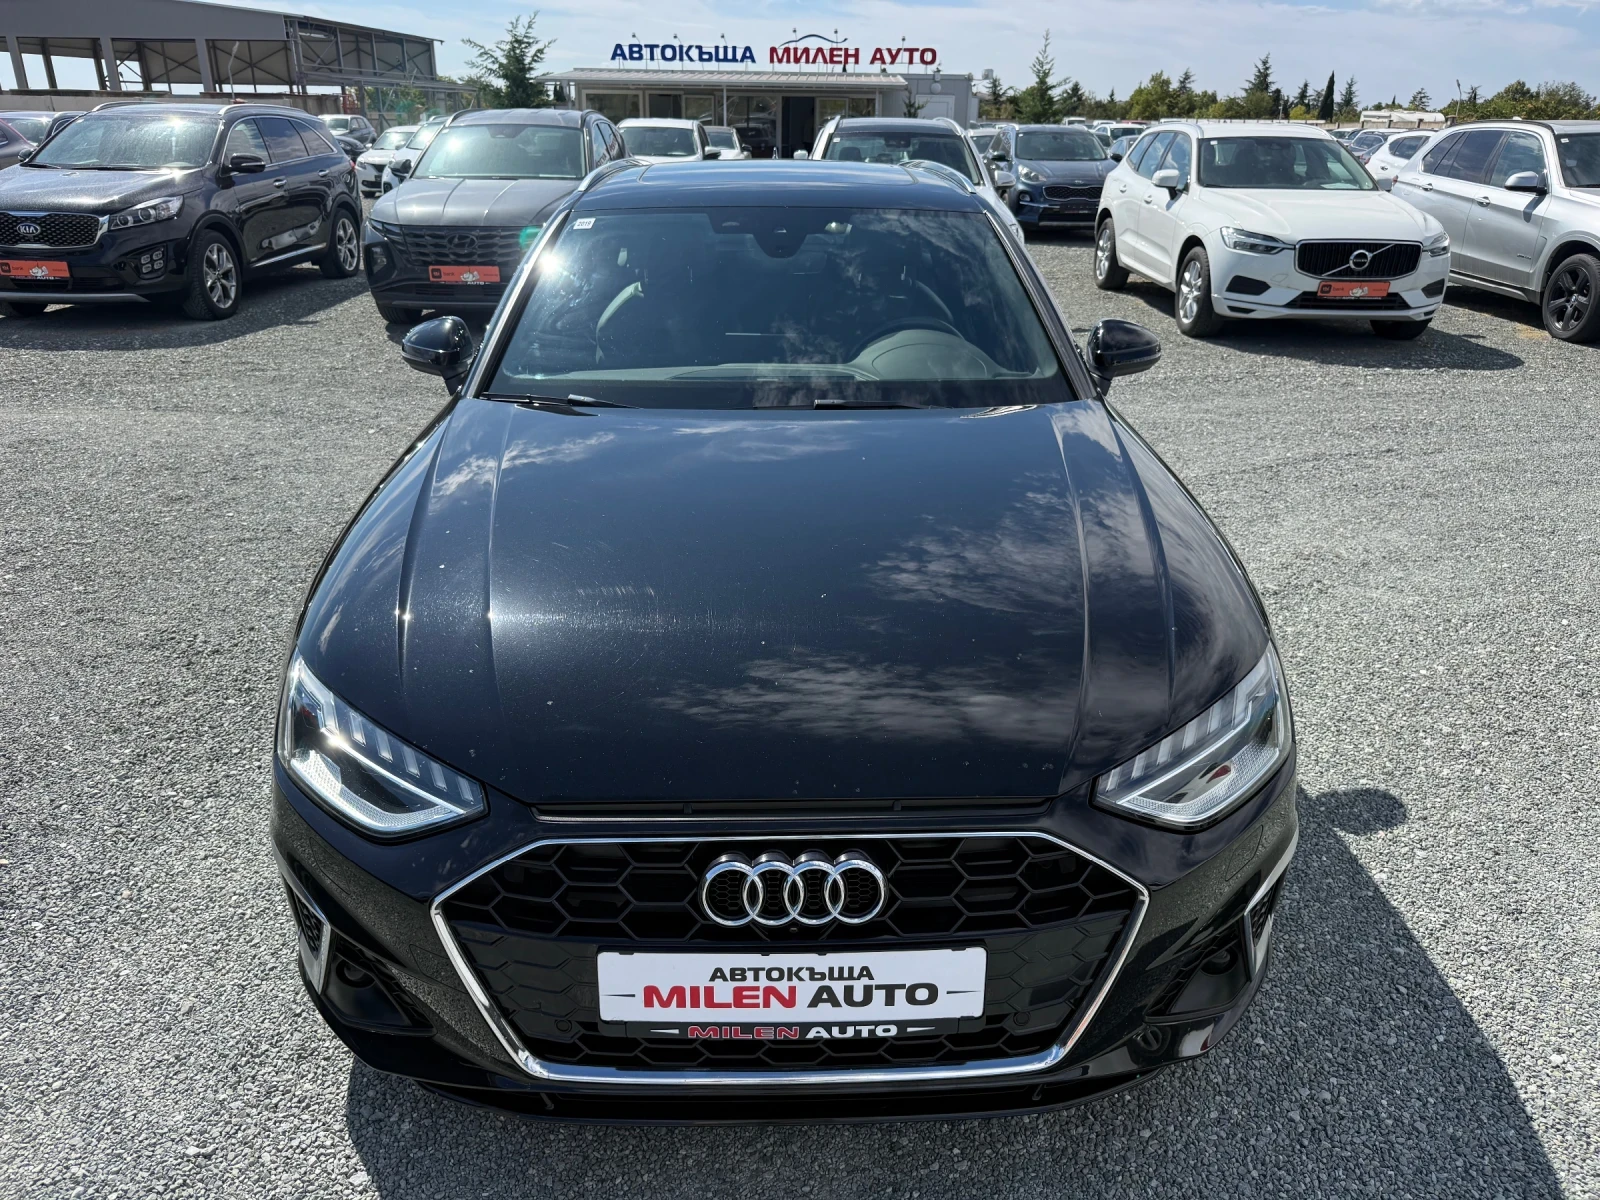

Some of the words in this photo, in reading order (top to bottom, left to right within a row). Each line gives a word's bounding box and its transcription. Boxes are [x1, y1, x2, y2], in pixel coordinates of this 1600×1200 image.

[611, 43, 757, 64] АВТОКЪЩА
[769, 46, 860, 65] МИЛЕН
[869, 47, 937, 65] АУТО
[19, 225, 37, 234] KIA
[643, 985, 797, 1009] MILEN
[807, 983, 939, 1008] AUTO
[688, 1025, 799, 1039] MILEN
[805, 1024, 898, 1039] AUTO
